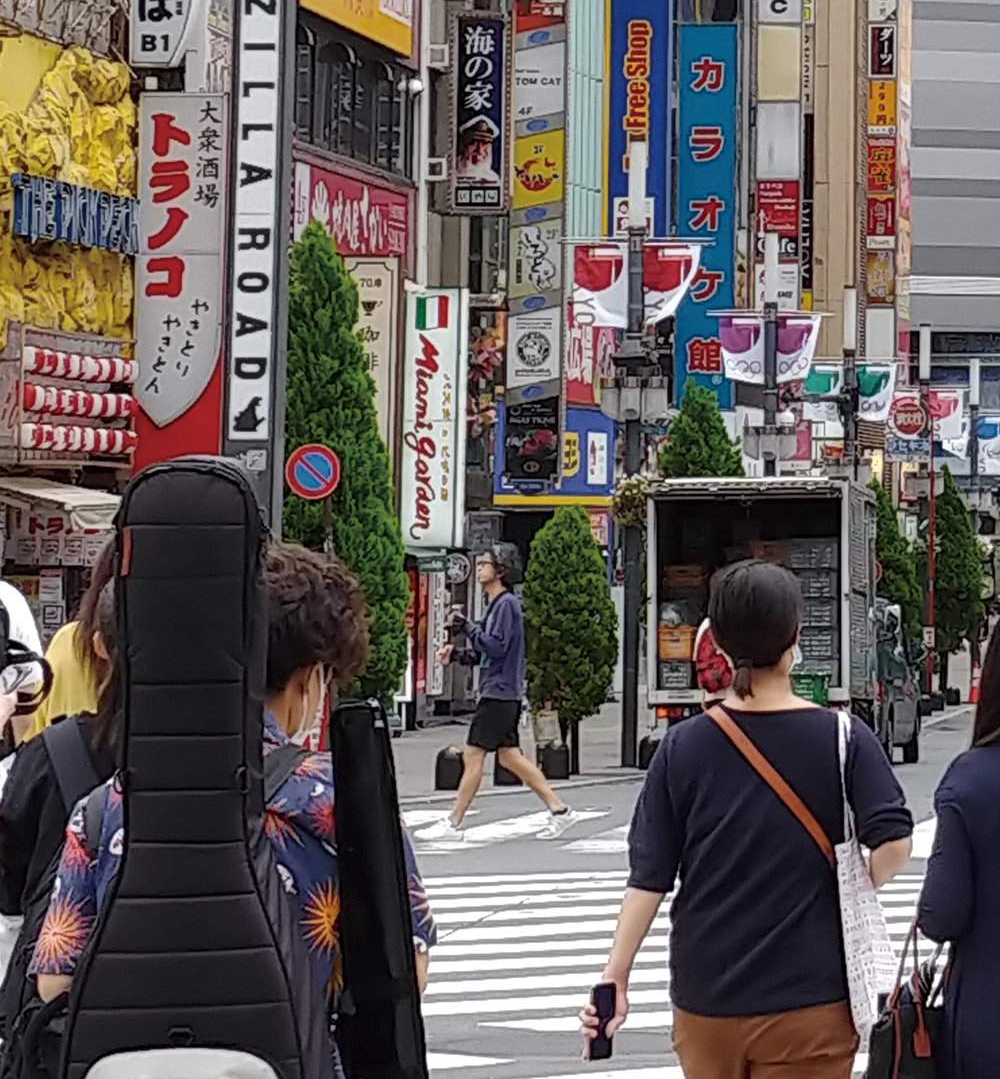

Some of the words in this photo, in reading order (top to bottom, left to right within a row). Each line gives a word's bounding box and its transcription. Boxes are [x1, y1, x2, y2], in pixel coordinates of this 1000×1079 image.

[140, 34, 169, 52] B1
[465, 25, 497, 111] 海の家
[515, 78, 537, 86] TOM
[541, 78, 562, 86] CAT
[518, 106, 533, 116] 4F
[193, 100, 222, 210] 大衆酒場
[144, 112, 192, 298] トラノコ
[686, 57, 726, 375] カラオケ館
[176, 299, 210, 378] やきとり
[233, 227, 272, 380] ROAD
[144, 313, 181, 395] やきとん
